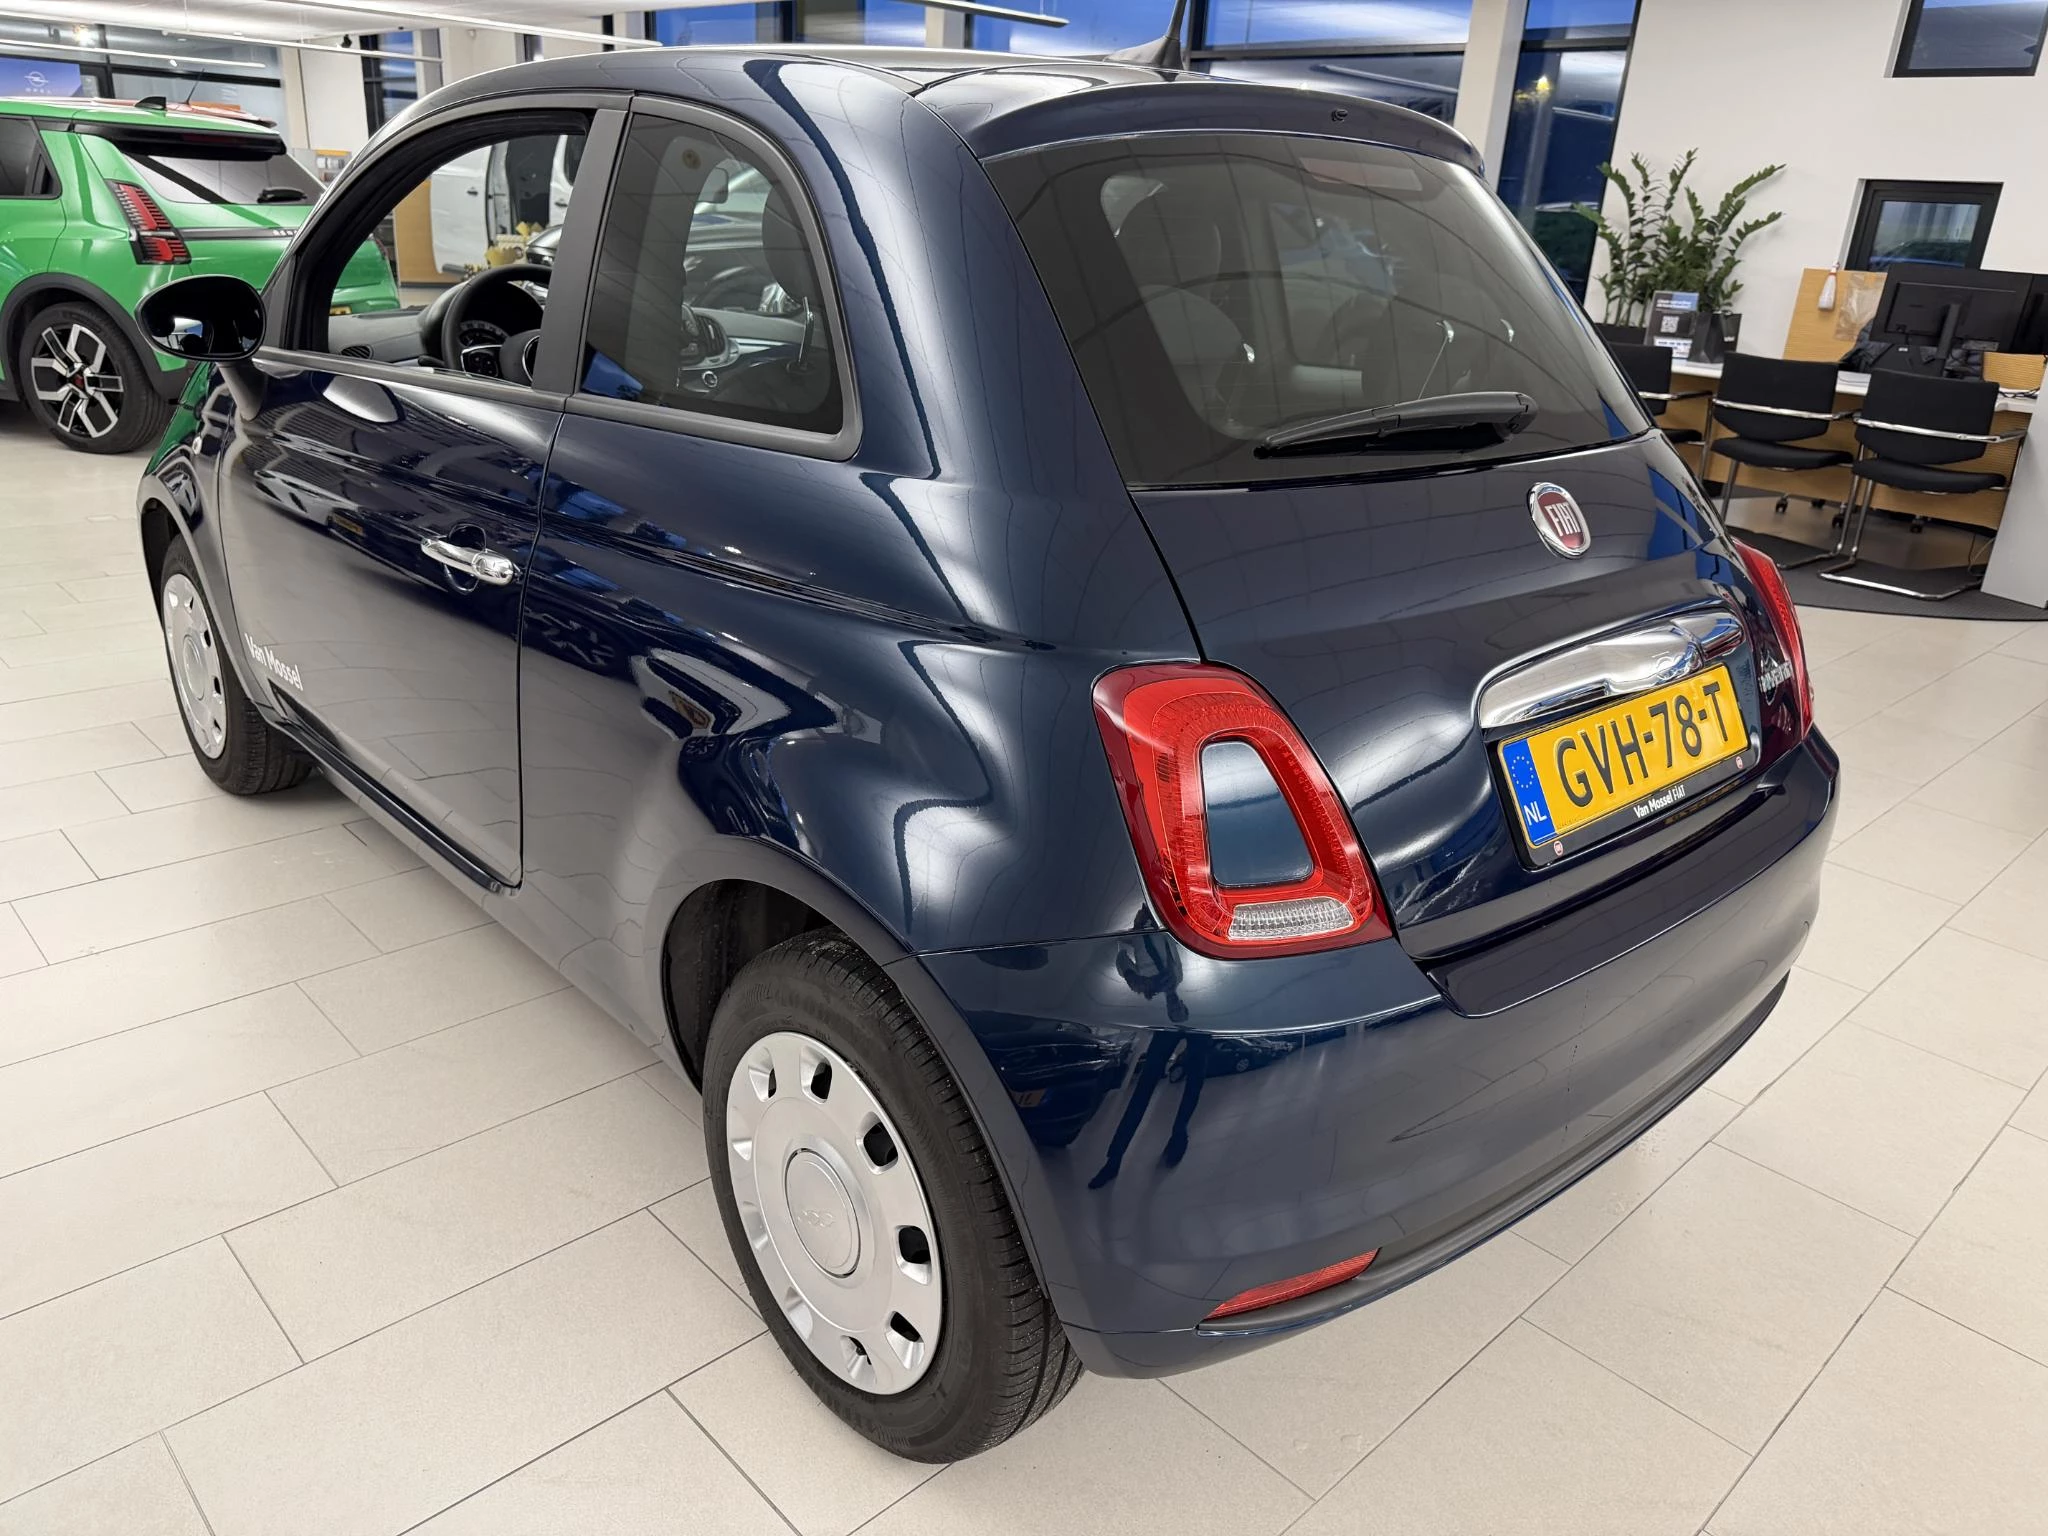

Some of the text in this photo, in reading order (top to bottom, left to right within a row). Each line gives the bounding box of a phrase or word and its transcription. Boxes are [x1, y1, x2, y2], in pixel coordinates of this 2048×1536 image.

[1544, 501, 1581, 536] FIAT
[244, 633, 303, 691] Van Mossel
[1556, 682, 1728, 807] GVH-78-T
[1523, 800, 1547, 826] NL
[1633, 805, 1650, 818] Van
[1648, 790, 1674, 812] Mossel
